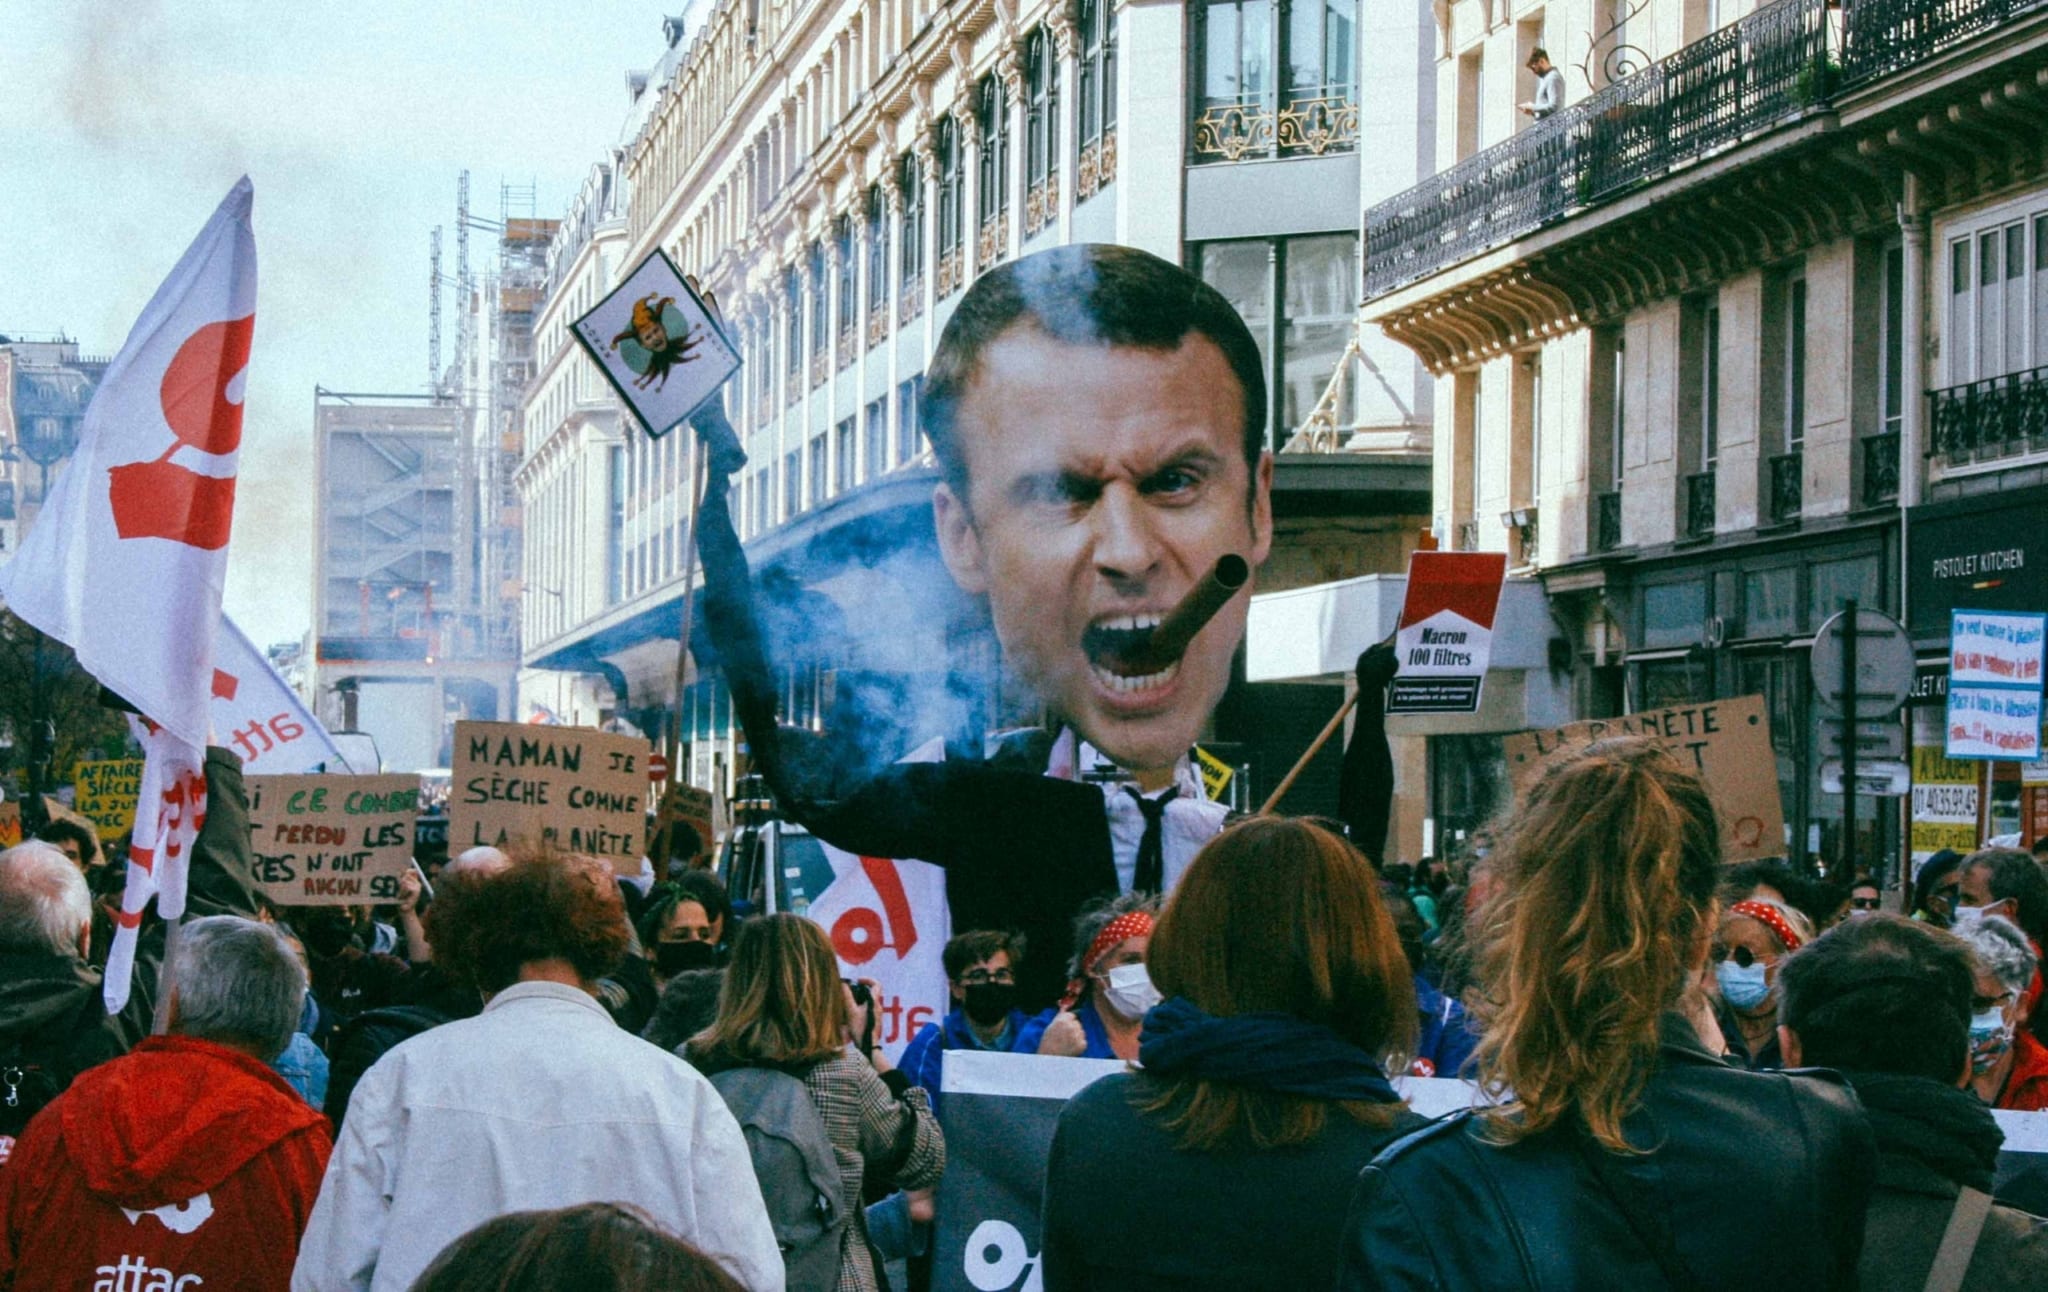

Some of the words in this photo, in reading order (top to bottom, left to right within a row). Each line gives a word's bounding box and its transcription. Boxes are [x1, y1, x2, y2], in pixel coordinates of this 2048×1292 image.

[1932, 554, 1978, 578] PISTOLET
[1980, 548, 2024, 572] KITCHEN
[1420, 627, 1467, 644] Macron
[1408, 648, 1430, 666] 100
[1433, 648, 1471, 666] filtres
[1936, 674, 1950, 695] KI
[470, 736, 582, 772] MAMAN
[608, 752, 635, 773] JE
[80, 763, 143, 778] AFFAIRE
[287, 788, 328, 814] CE
[464, 772, 550, 805] SÈCHE
[568, 786, 639, 813] COMME
[82, 800, 100, 811] LA
[275, 824, 346, 847] PERDU
[363, 822, 406, 848] LES
[543, 824, 633, 855] PLANÈTE
[307, 852, 373, 873] N'ONT
[304, 877, 362, 896] AUCUN
